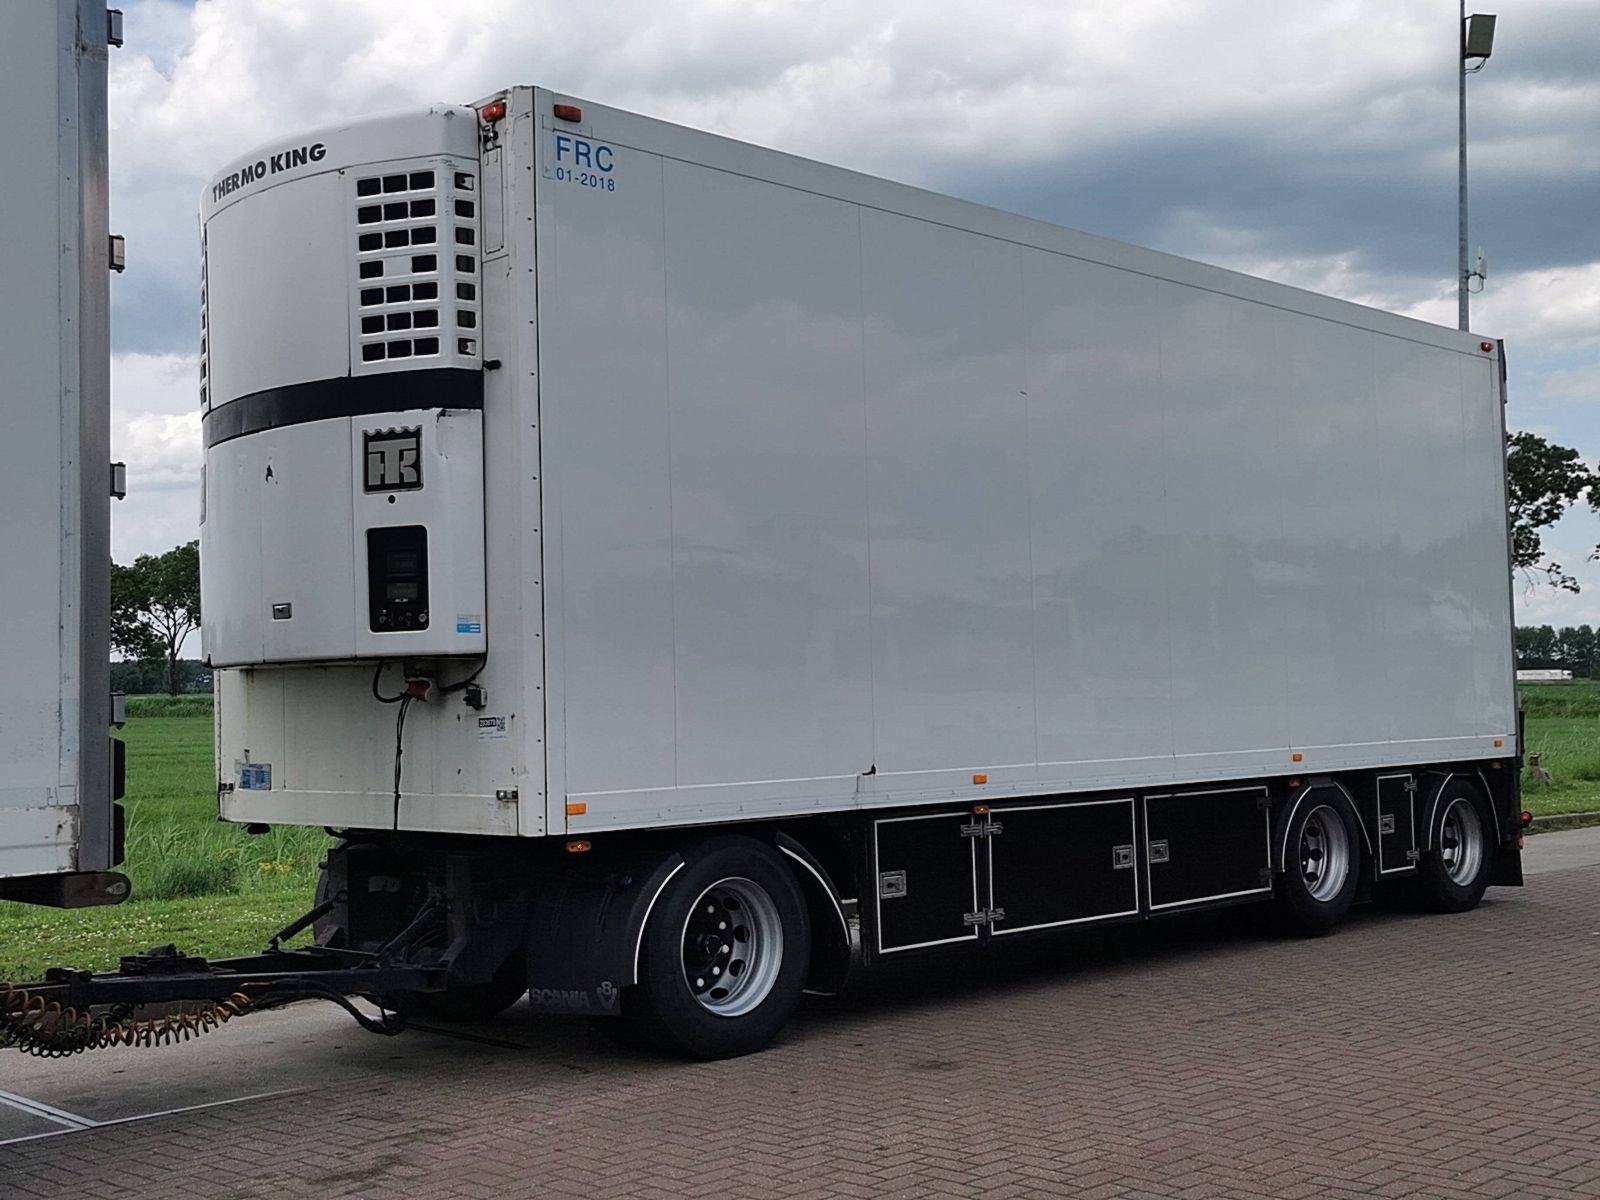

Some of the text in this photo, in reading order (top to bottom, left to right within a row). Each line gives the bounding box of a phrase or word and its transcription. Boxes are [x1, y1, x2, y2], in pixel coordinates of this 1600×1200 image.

[557, 136, 613, 172] FRC
[212, 143, 326, 203] THERMO KING
[556, 167, 615, 192] 01-2018
[531, 988, 590, 1009] SCANIA
